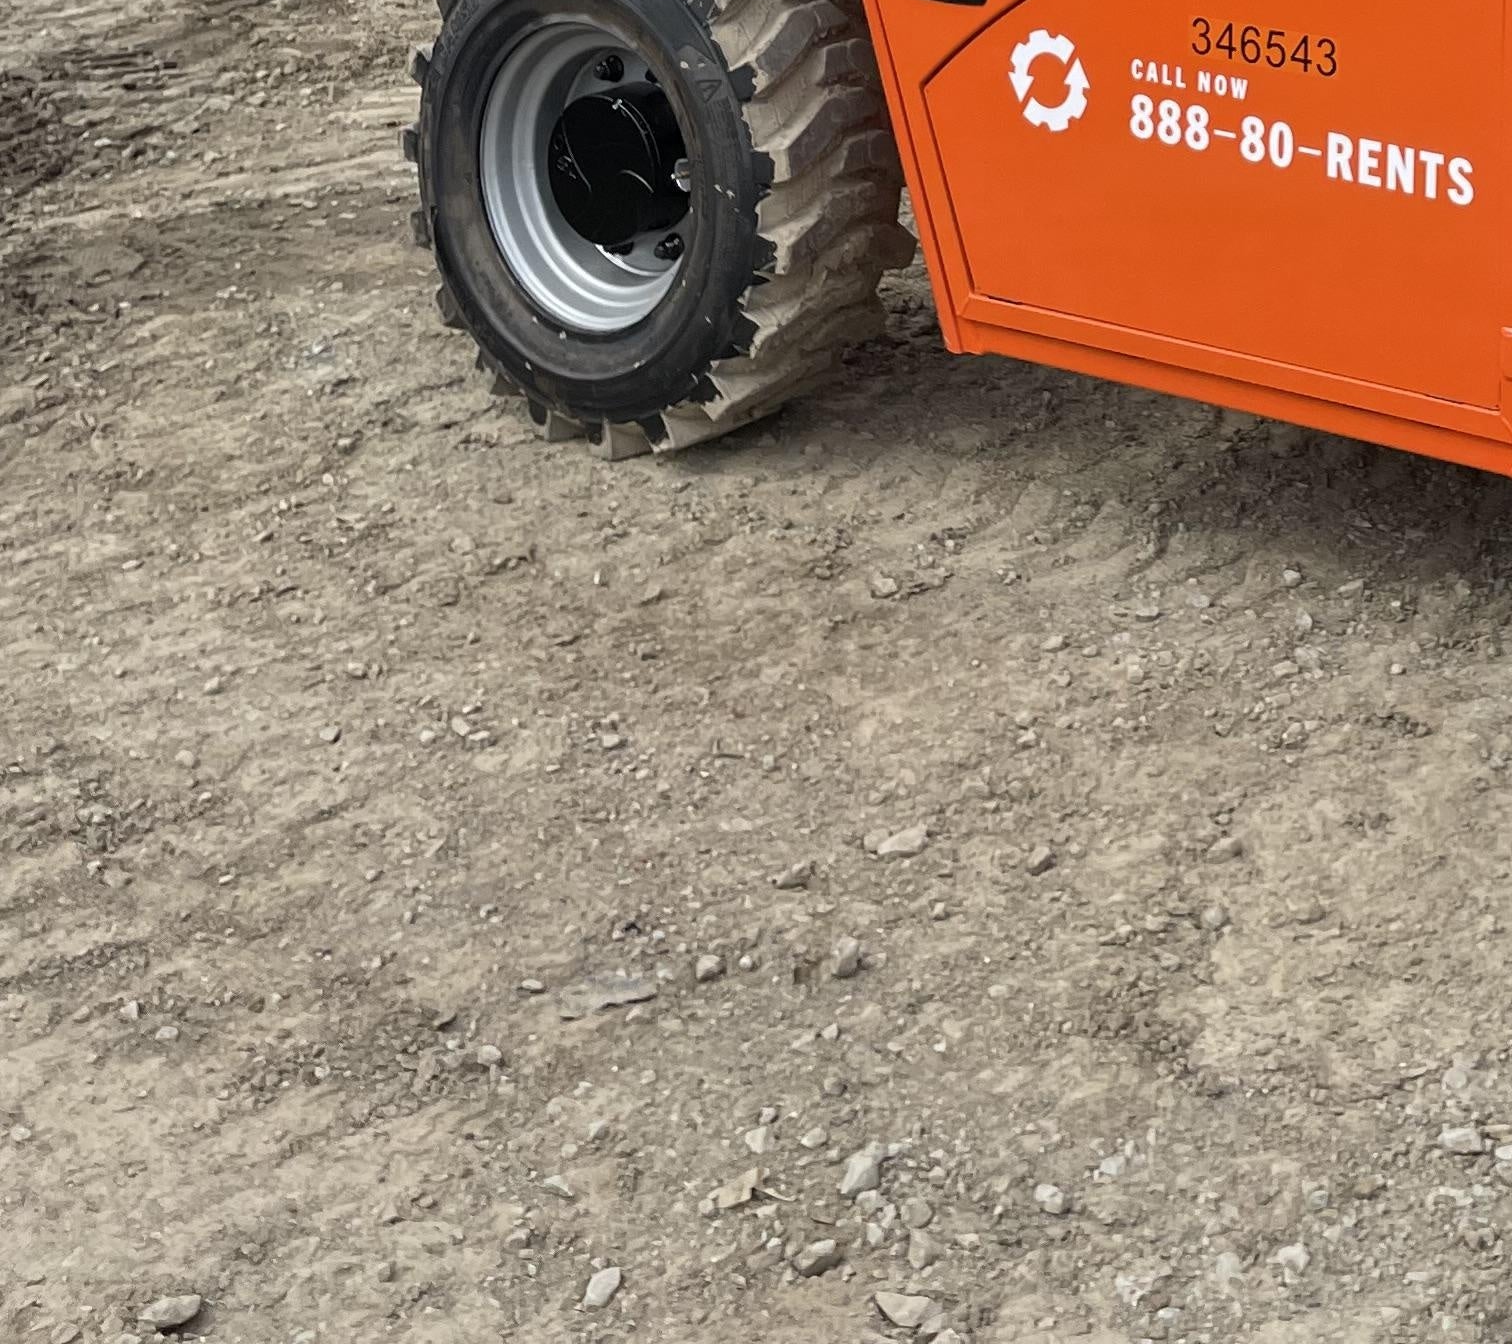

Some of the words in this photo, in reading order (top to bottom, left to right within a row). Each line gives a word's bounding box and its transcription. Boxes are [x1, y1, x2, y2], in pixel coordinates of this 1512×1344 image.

[1191, 17, 1338, 76] 346543
[1131, 58, 1186, 89] CALL
[1198, 70, 1248, 100] NOW
[1129, 93, 1474, 206] 888-80-RENTS
